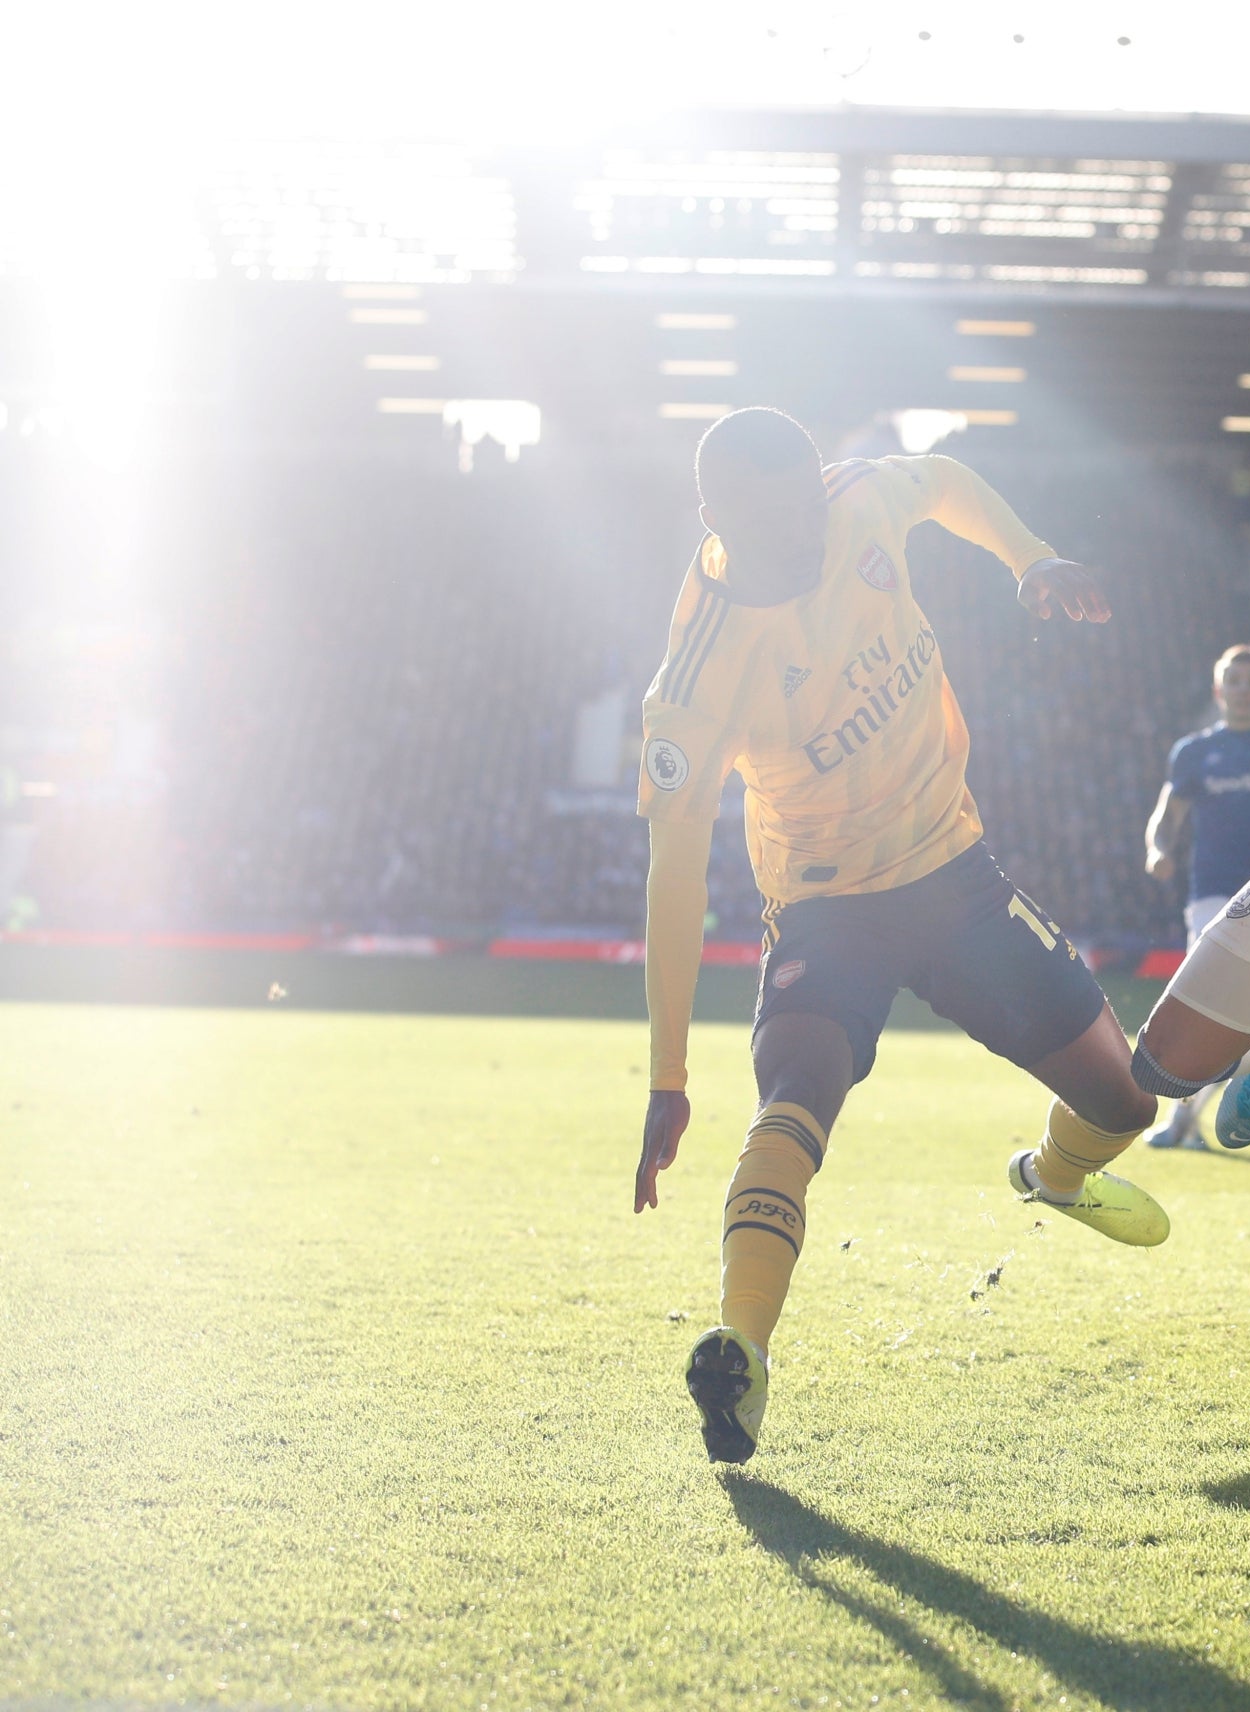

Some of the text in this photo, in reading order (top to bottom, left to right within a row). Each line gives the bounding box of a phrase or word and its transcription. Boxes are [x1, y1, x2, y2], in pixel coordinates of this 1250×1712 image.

[785, 667, 812, 698] adidas
[842, 634, 892, 690] Fly
[802, 619, 937, 774] Emirates
[1008, 889, 1061, 952] 1
[738, 1200, 797, 1229] AFC
